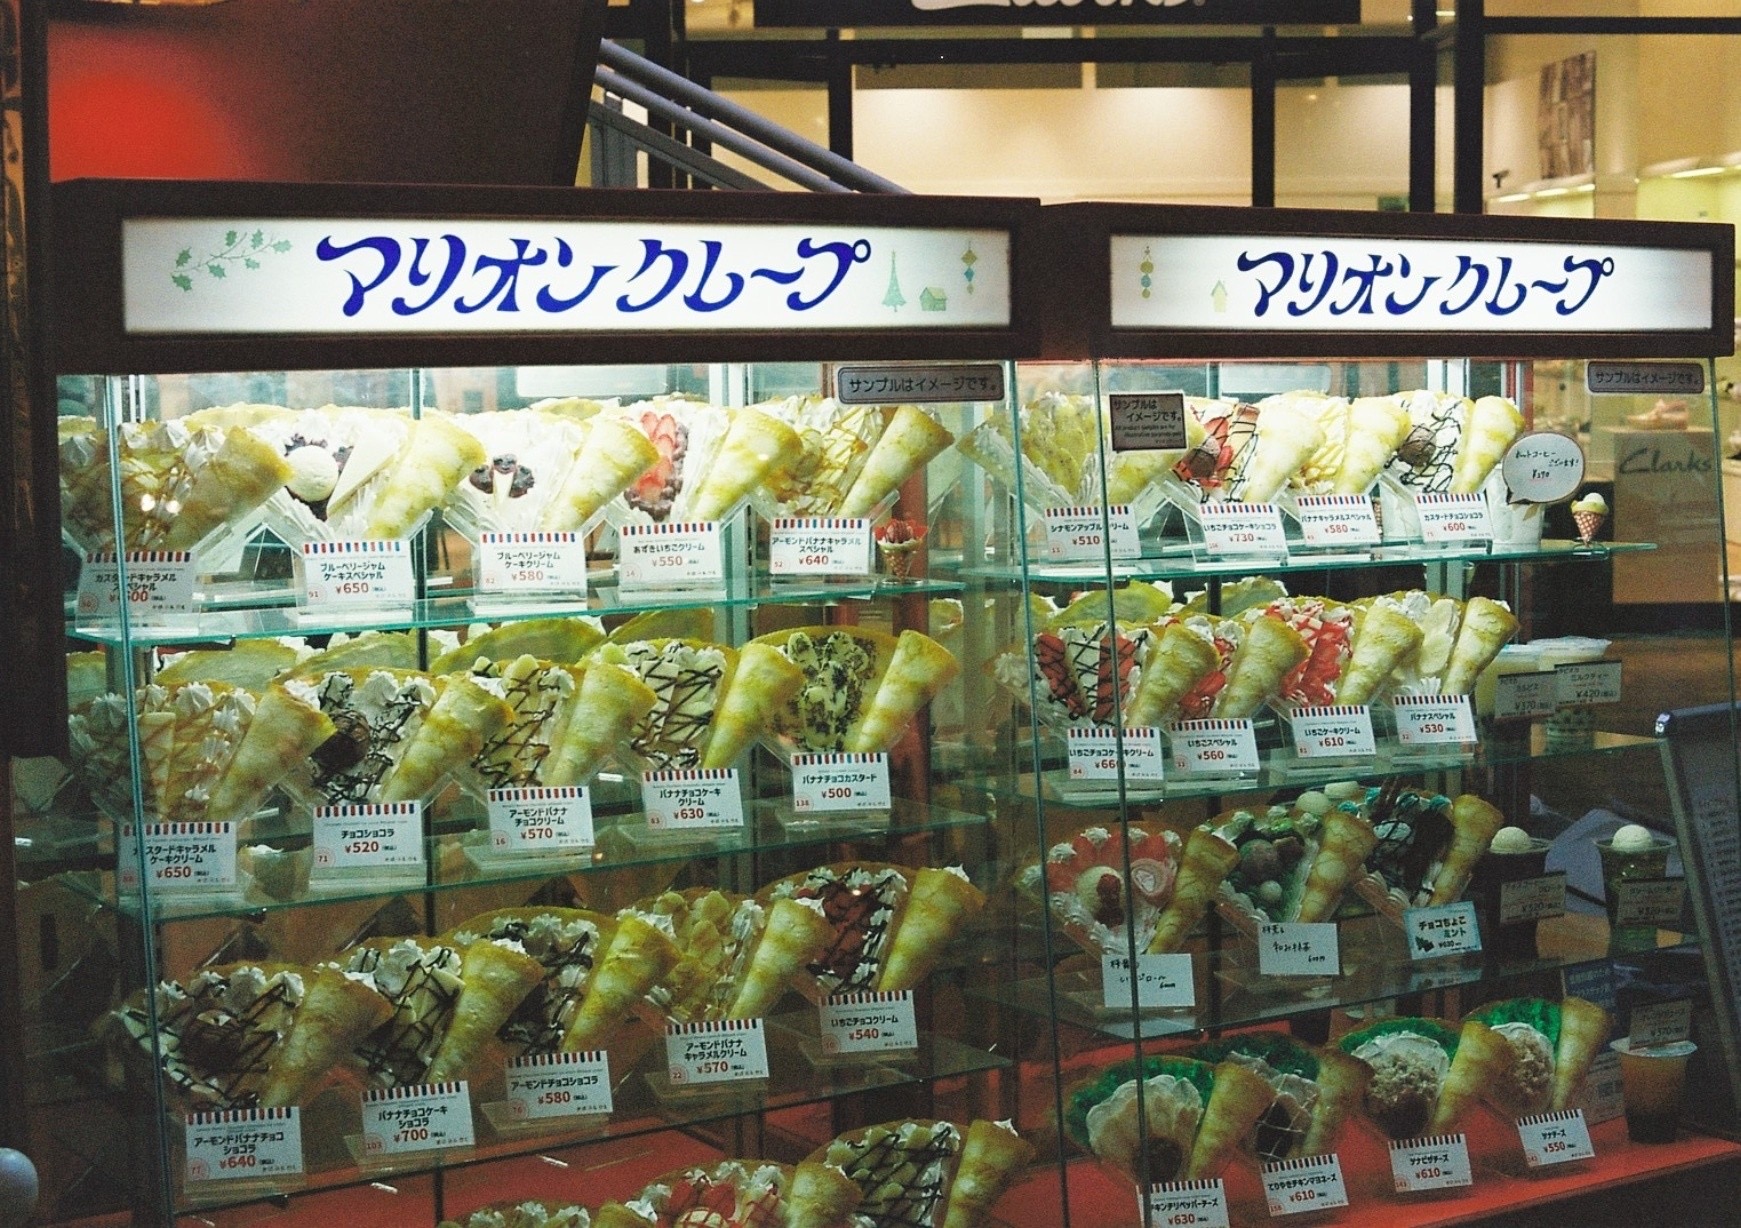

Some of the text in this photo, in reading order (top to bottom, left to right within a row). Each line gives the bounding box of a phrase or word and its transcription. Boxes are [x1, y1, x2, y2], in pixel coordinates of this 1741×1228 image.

[316, 234, 871, 317] マリオンクレープ
[1236, 249, 1614, 317] マリオンクレープ
[1595, 371, 1701, 385] サンプルはイメージです。
[849, 376, 997, 394] サンプルはイメージです。
[1126, 410, 1181, 422] イメージです。
[1051, 523, 1130, 532] シナモンアップルリーム
[1072, 536, 1100, 545] ¥510
[1229, 533, 1254, 542] ¥730
[633, 543, 705, 554] あずきいちごクリーム
[497, 551, 561, 560] ブルーベリージャム
[799, 555, 829, 565] ¥640
[320, 562, 386, 572] ブルーベリージャム
[505, 560, 554, 569] ケーキクリーム
[652, 556, 683, 567] ¥550
[95, 573, 177, 582] カスタドキャラメル
[324, 571, 384, 581] ケーキスペシャル
[511, 570, 544, 581] ¥580
[336, 582, 369, 594] ¥650
[1410, 712, 1456, 721] バナナスペシャル
[1304, 726, 1361, 736] いちごケーキクリーム
[1420, 723, 1444, 733] ¥530
[1187, 739, 1238, 748] いちごスペシャル
[1319, 737, 1344, 747] ¥610
[1069, 748, 1154, 757] いちごチョコケキクリーム
[1197, 751, 1224, 760] ¥560
[660, 788, 721, 799] バナナチョコケーキ
[821, 788, 851, 799] ¥500
[678, 798, 705, 807] クリーム
[509, 806, 568, 816] アーモンドバナナ
[673, 808, 703, 820] ¥630
[515, 816, 565, 827] チョコクリーム
[341, 828, 395, 839] チョコショコラ
[521, 828, 553, 840] ¥570
[344, 841, 379, 854] ¥520
[150, 854, 204, 865] ケーキクリーム
[156, 865, 192, 879] ¥650
[1444, 927, 1467, 938] ミント
[830, 1015, 898, 1028] いちごチョコクリーム
[848, 1028, 880, 1040] ¥540
[686, 1039, 743, 1052] アーモンドバナナ
[684, 1048, 747, 1061] キャラメルクリーム
[697, 1061, 729, 1075] ¥570
[510, 1076, 599, 1090] アーモンドチョコショコラ
[538, 1091, 571, 1105] ¥580
[378, 1105, 448, 1121] バナナチョコケーキ
[398, 1118, 430, 1130] ショコラ
[194, 1131, 285, 1147] アーモンドバナナチョコ
[393, 1128, 428, 1144] ¥700
[223, 1144, 257, 1155] ショコラ
[1543, 1141, 1566, 1153] ¥550
[219, 1154, 256, 1170] ¥640
[1415, 1167, 1441, 1179] ¥610
[1289, 1189, 1315, 1202] ¥610
[1168, 1213, 1195, 1225] ¥630
